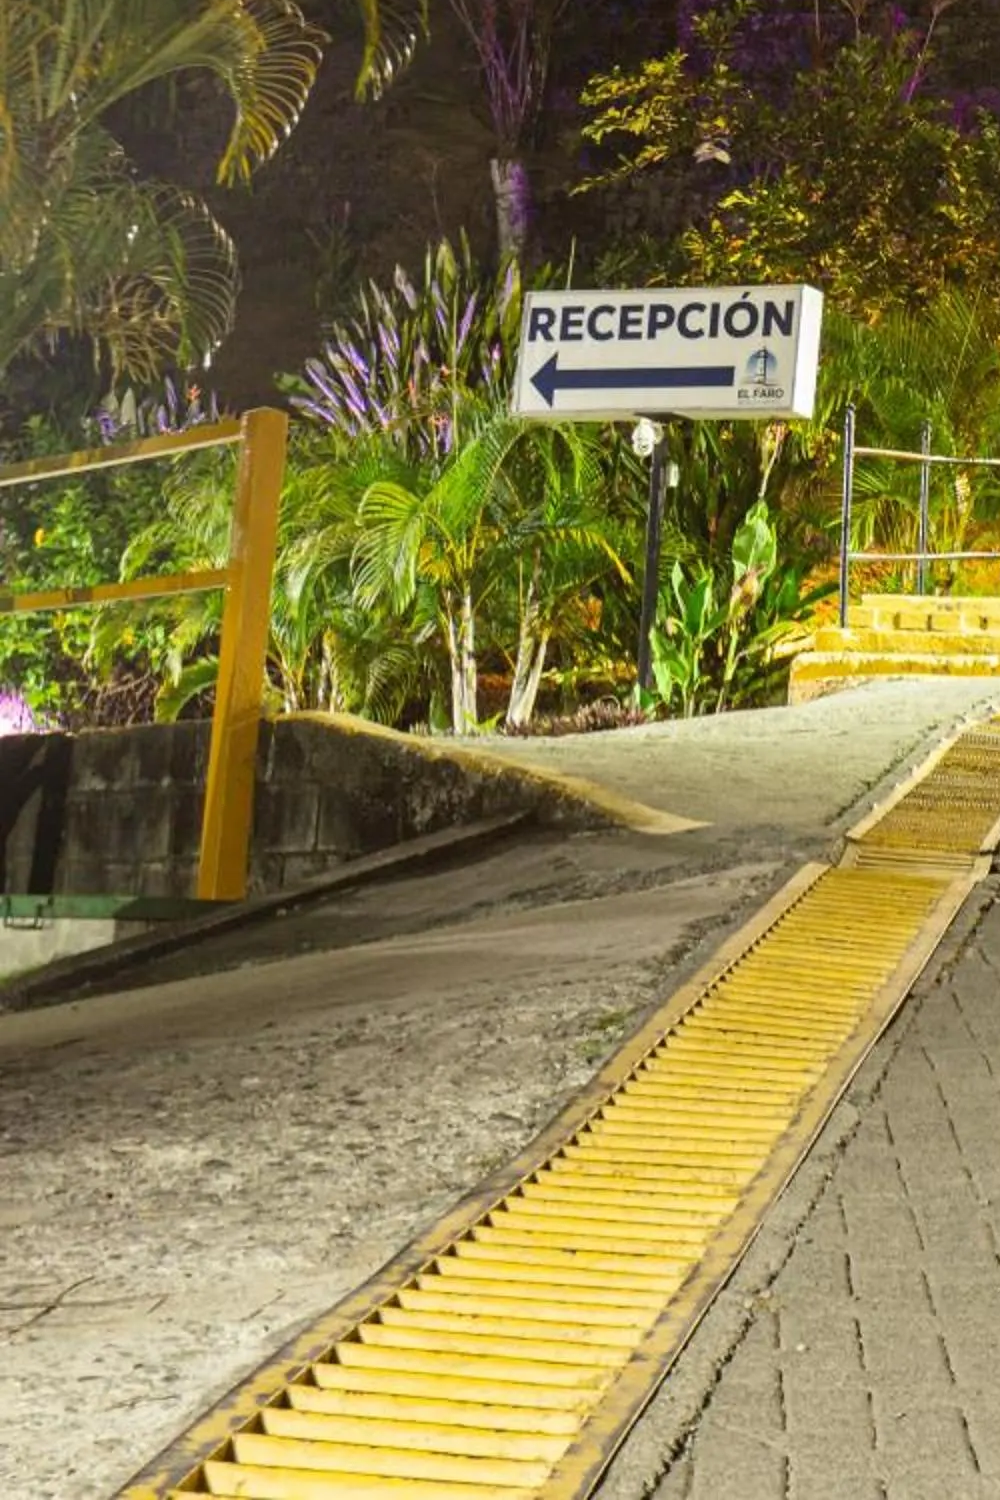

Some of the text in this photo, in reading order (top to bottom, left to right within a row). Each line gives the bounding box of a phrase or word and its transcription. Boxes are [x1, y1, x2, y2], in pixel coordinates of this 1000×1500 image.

[528, 292, 794, 342] RECEPCIÓN
[737, 387, 785, 399] EL FARO
